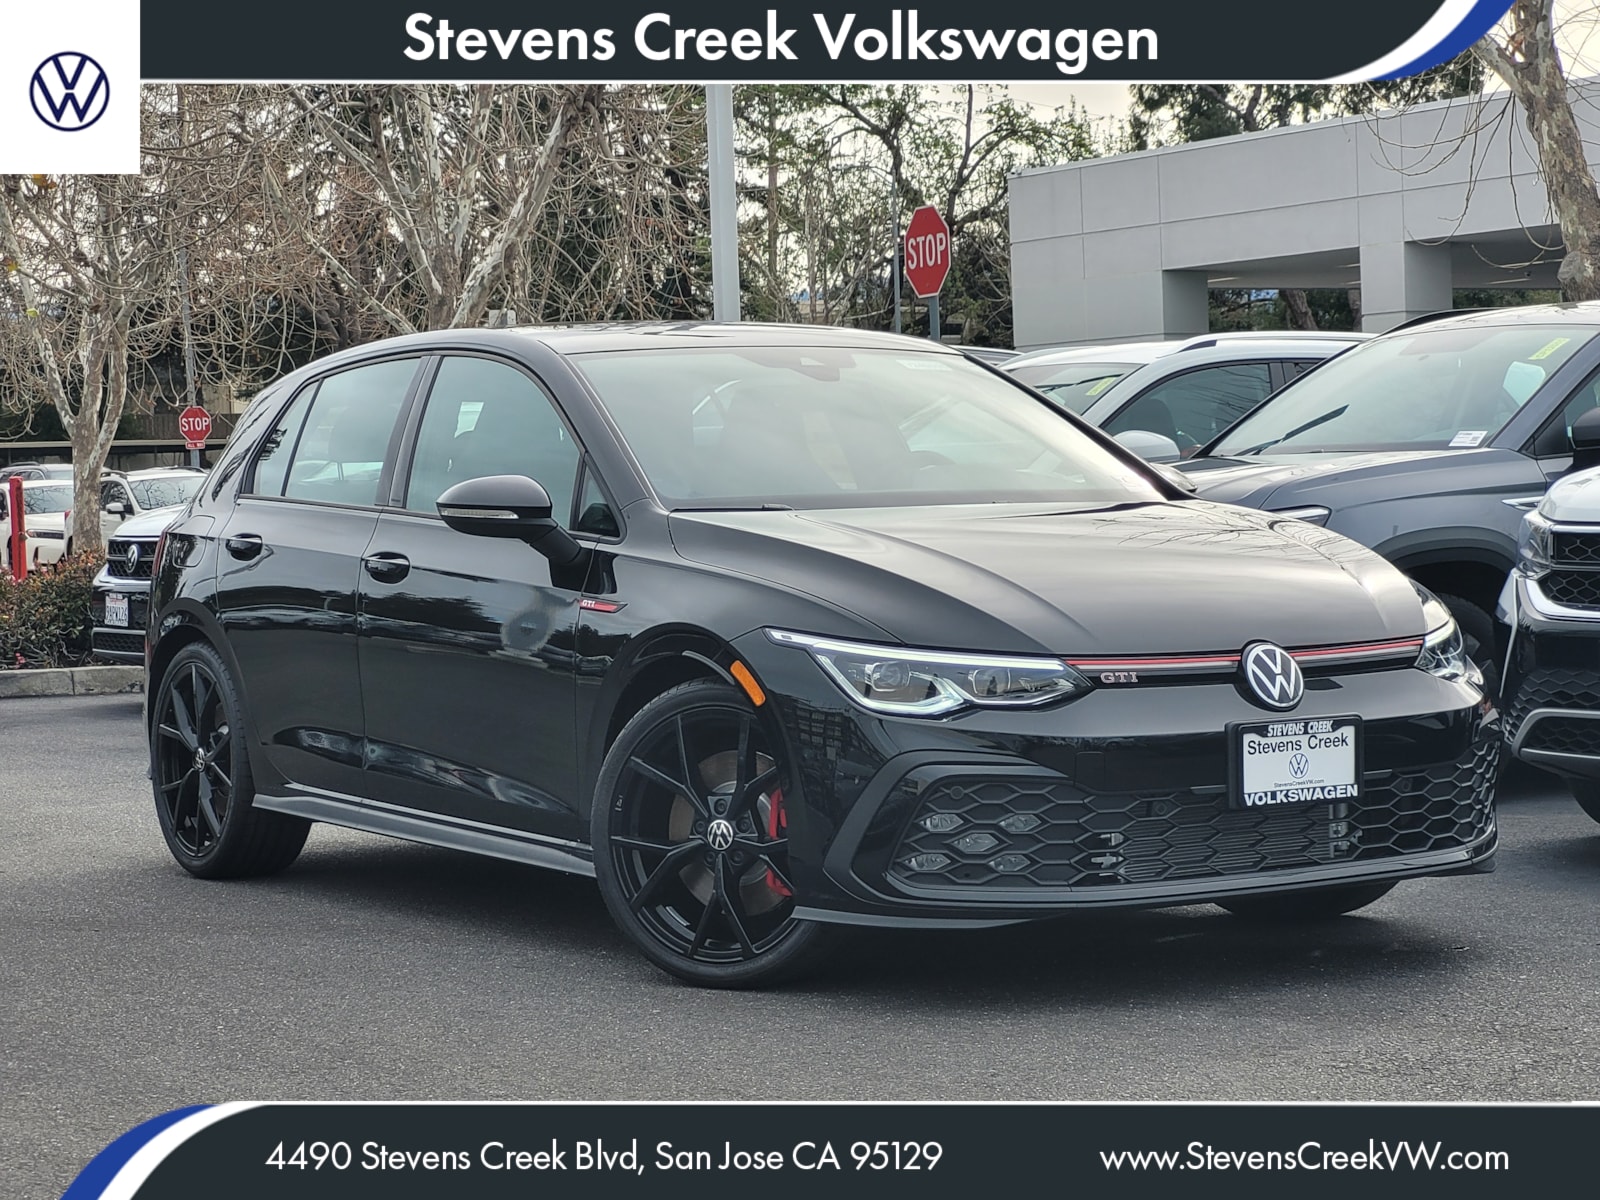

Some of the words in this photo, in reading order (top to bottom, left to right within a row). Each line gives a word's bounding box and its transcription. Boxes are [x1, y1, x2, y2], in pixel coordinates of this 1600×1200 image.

[908, 232, 946, 270] STOP
[181, 417, 209, 431] STOP
[582, 599, 596, 608] GTI
[1100, 671, 1139, 684] GTI
[1267, 722, 1305, 737] STEVENS
[1308, 720, 1333, 734] CREEK
[1247, 740, 1302, 755] Stevens
[1307, 732, 1349, 749] Creek
[1274, 779, 1325, 788] StevensCreekVW.com
[1244, 784, 1358, 806] VOLKSWAGEN
